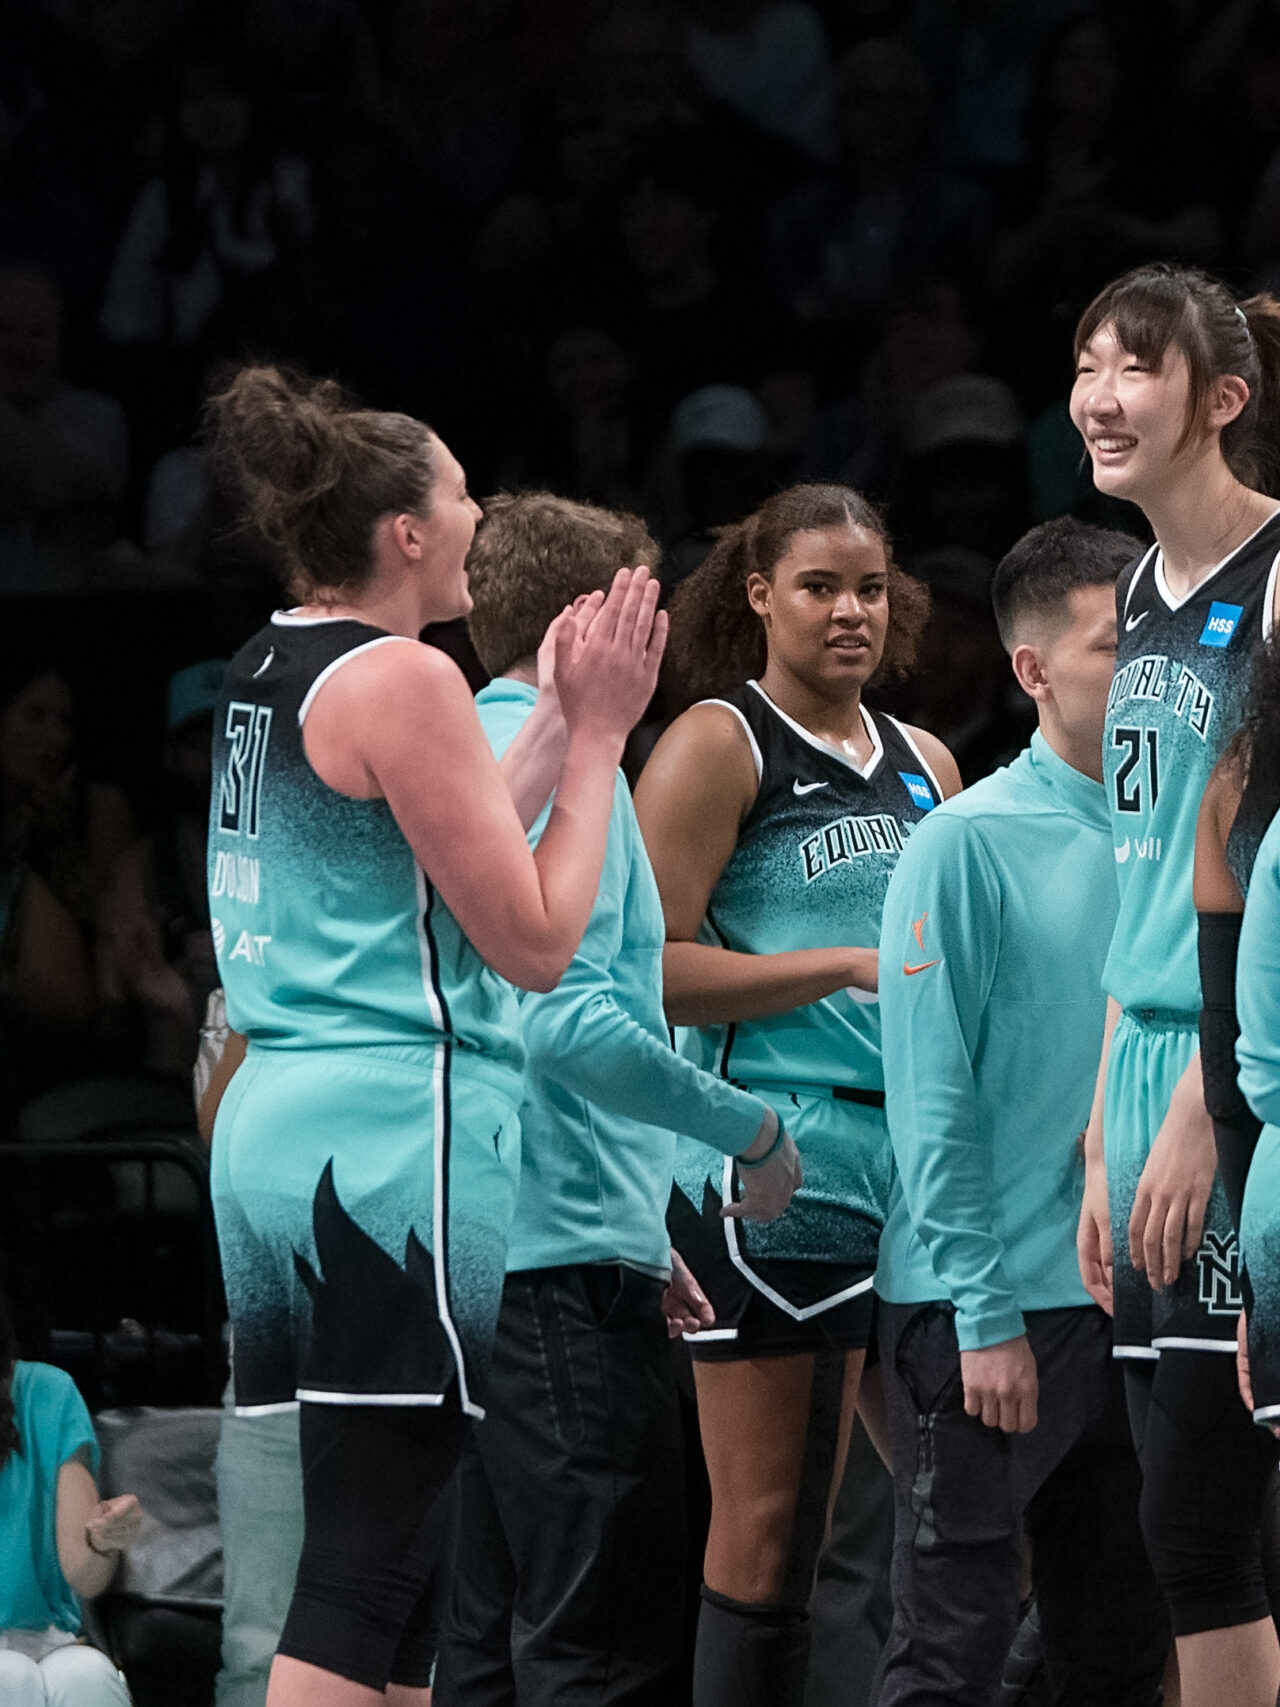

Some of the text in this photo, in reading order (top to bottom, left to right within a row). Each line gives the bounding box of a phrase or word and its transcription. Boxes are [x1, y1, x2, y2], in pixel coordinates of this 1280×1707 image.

[1207, 617, 1234, 634] HSS
[217, 700, 273, 839] 31
[908, 783, 930, 799] HSS
[1112, 725, 1159, 815] 21
